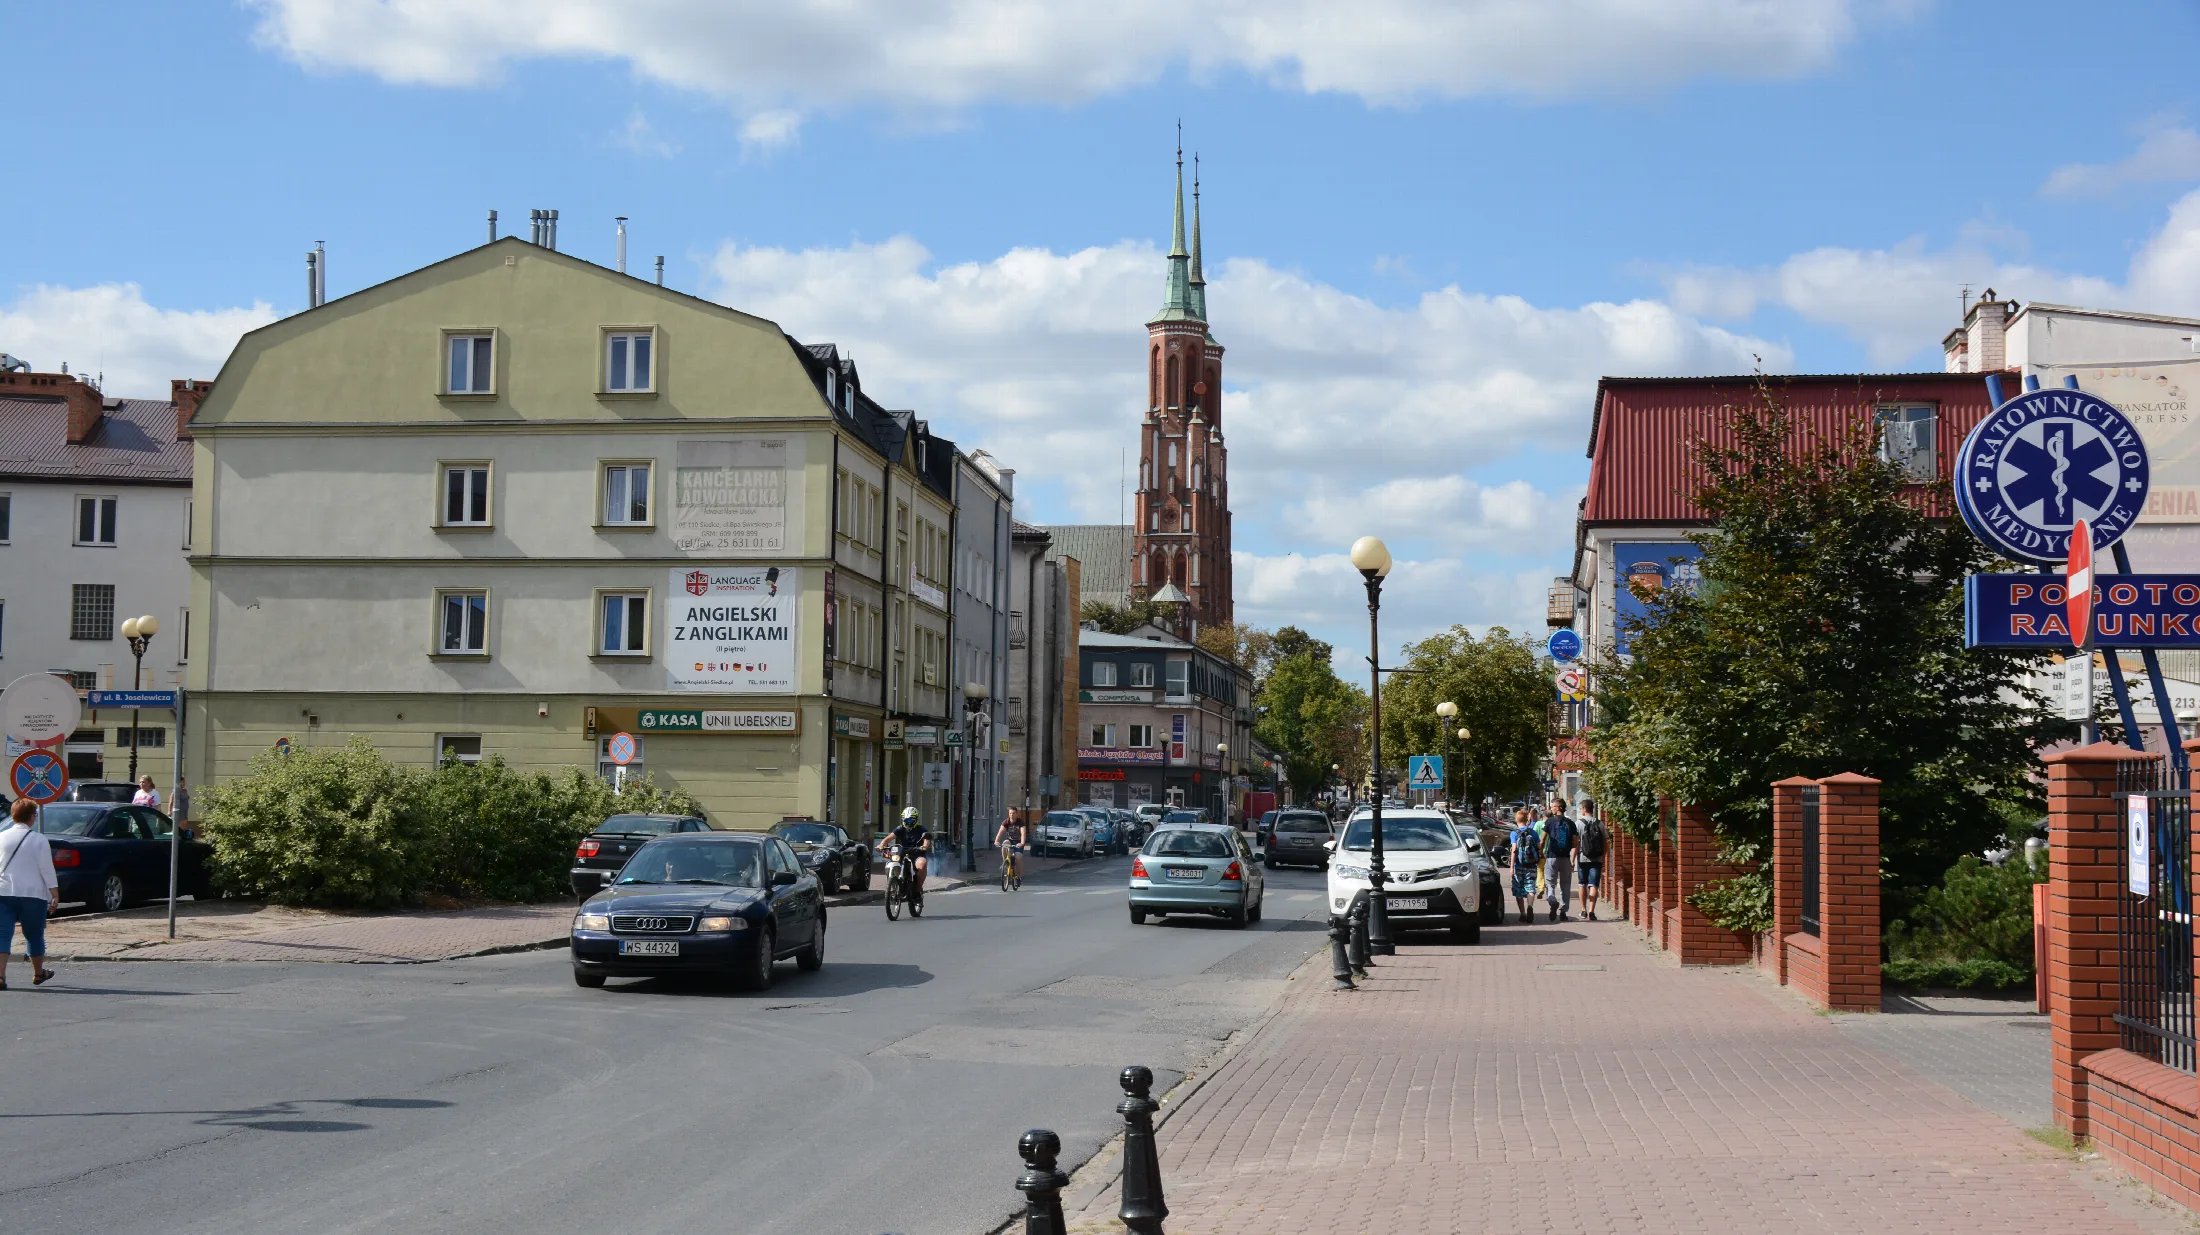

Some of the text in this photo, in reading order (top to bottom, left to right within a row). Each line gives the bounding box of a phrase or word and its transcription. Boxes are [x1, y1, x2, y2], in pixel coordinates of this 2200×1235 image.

[1975, 396, 2141, 470] RATOWNICTWO
[683, 472, 778, 487] KANCELARIA
[682, 488, 778, 504] ADWOKACKA
[717, 538, 729, 547] 25
[732, 538, 748, 547] 631
[753, 538, 763, 547] 01
[768, 538, 778, 547] 61
[686, 607, 777, 621] ANGIELSKI
[2010, 614, 2200, 636] RAUNK
[675, 627, 788, 640] Z ANGLIKAMI
[2175, 698, 2195, 708] 213
[659, 715, 792, 726] KASA UNII LUBELSKIEJ
[1102, 750, 1135, 760] Języków
[1136, 750, 1164, 761] Obcych
[1078, 768, 1127, 781] mBank
[626, 942, 677, 953] WS 44324
